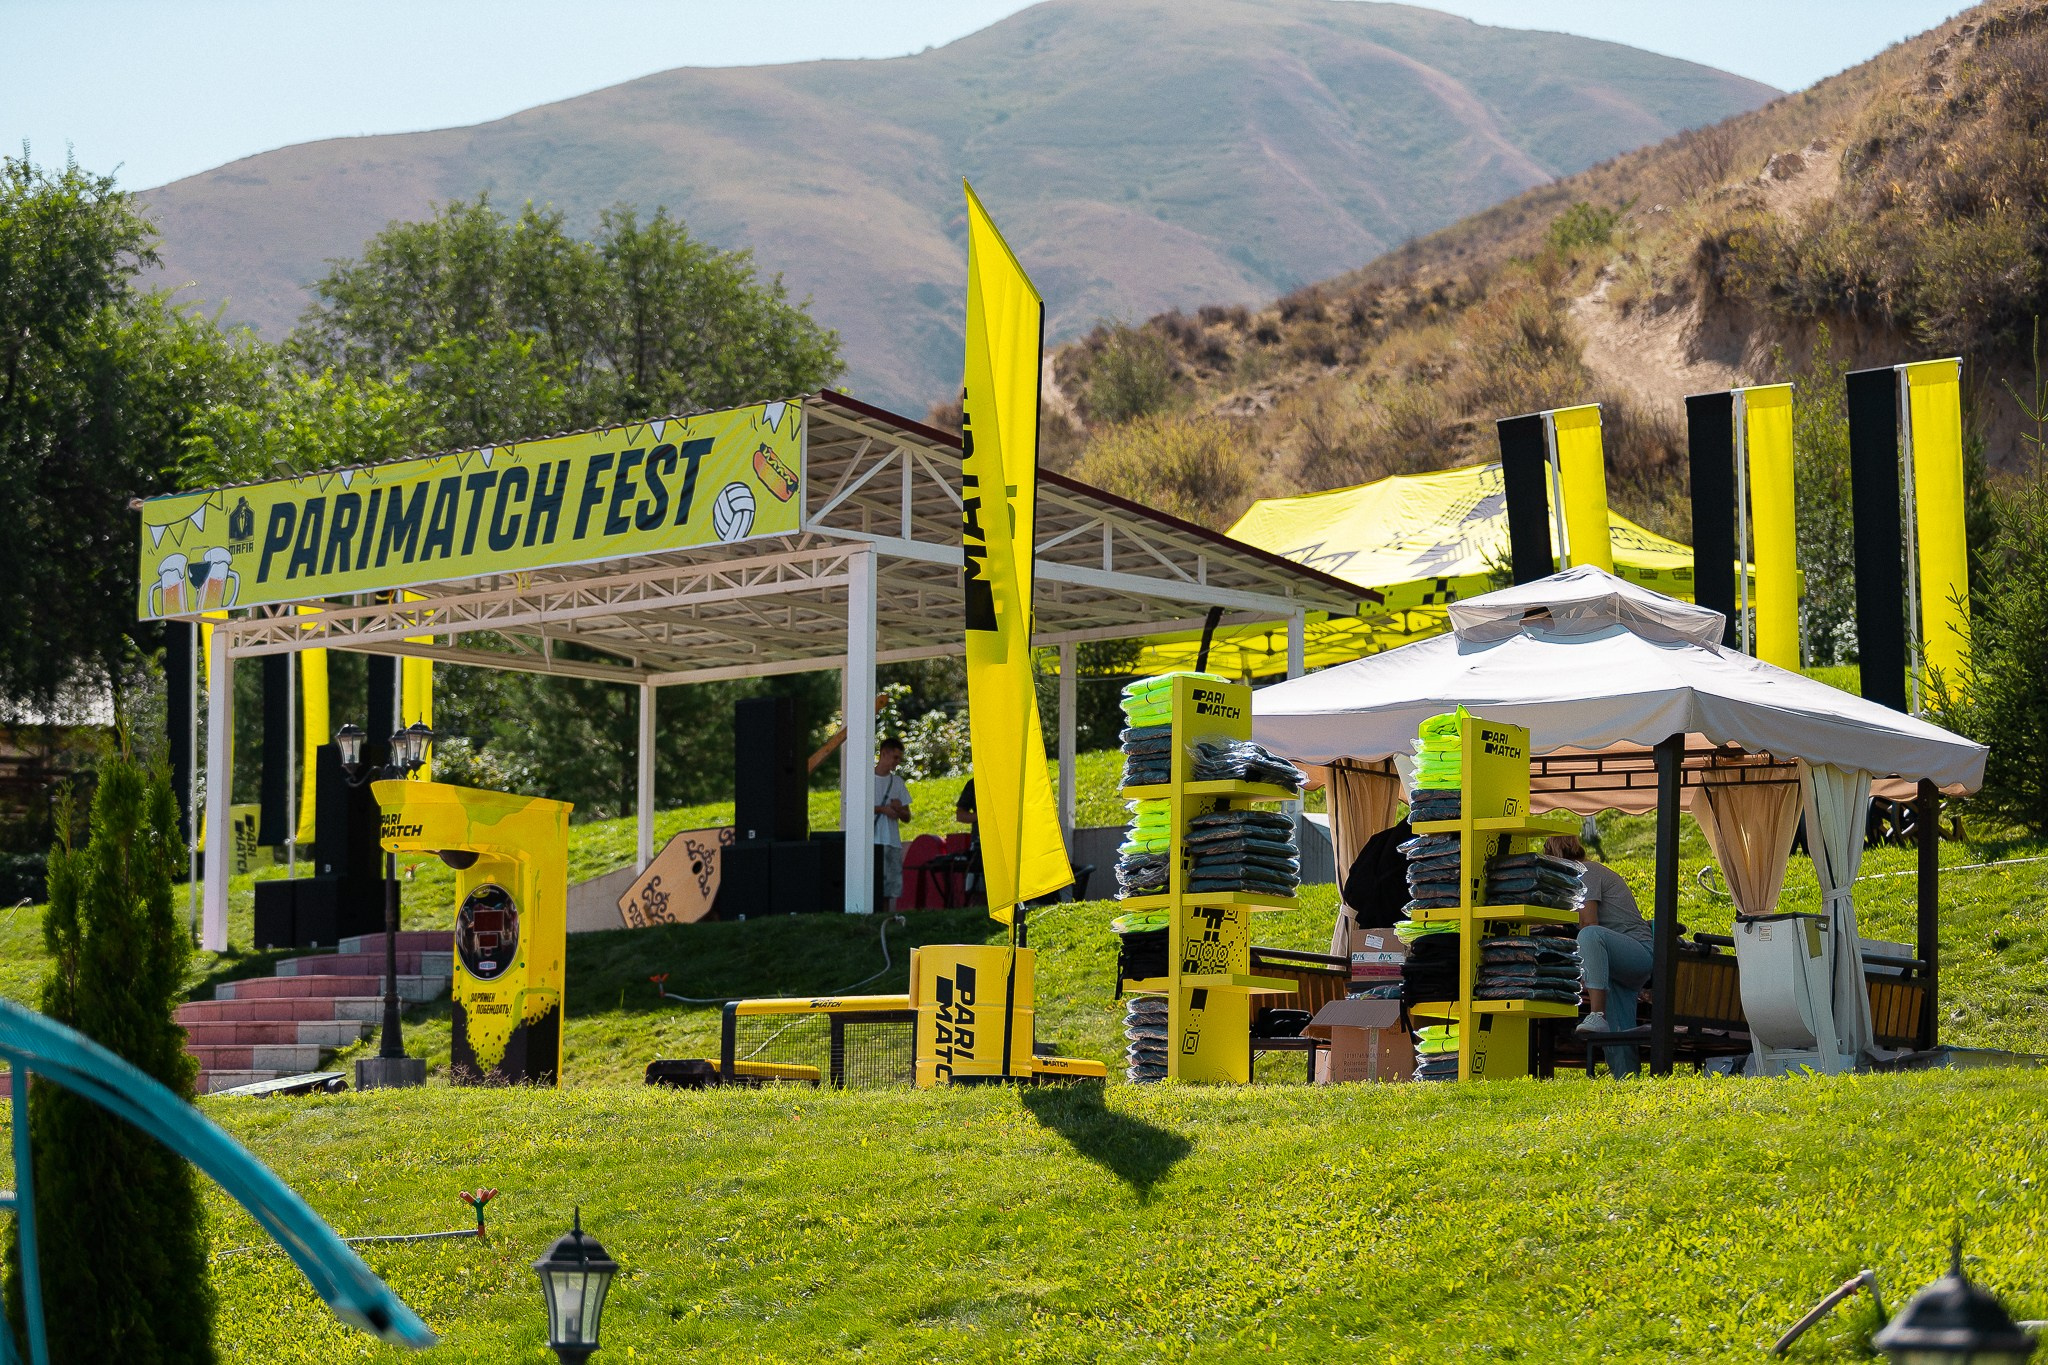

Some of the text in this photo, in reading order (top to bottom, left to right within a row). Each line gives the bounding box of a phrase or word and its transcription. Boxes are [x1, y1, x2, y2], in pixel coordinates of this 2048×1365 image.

[256, 437, 716, 583] PARIMATCH FEST
[229, 541, 254, 555] MAFIA
[1192, 689, 1225, 704] PARI
[1196, 702, 1240, 719] MATCH
[1481, 730, 1508, 744] PARI
[1485, 742, 1521, 759] MATCH
[381, 813, 401, 825] PARI
[245, 814, 257, 857] PARI
[381, 824, 423, 838] MATCH
[954, 962, 977, 1061] PARI
[935, 975, 954, 1085] MATC
